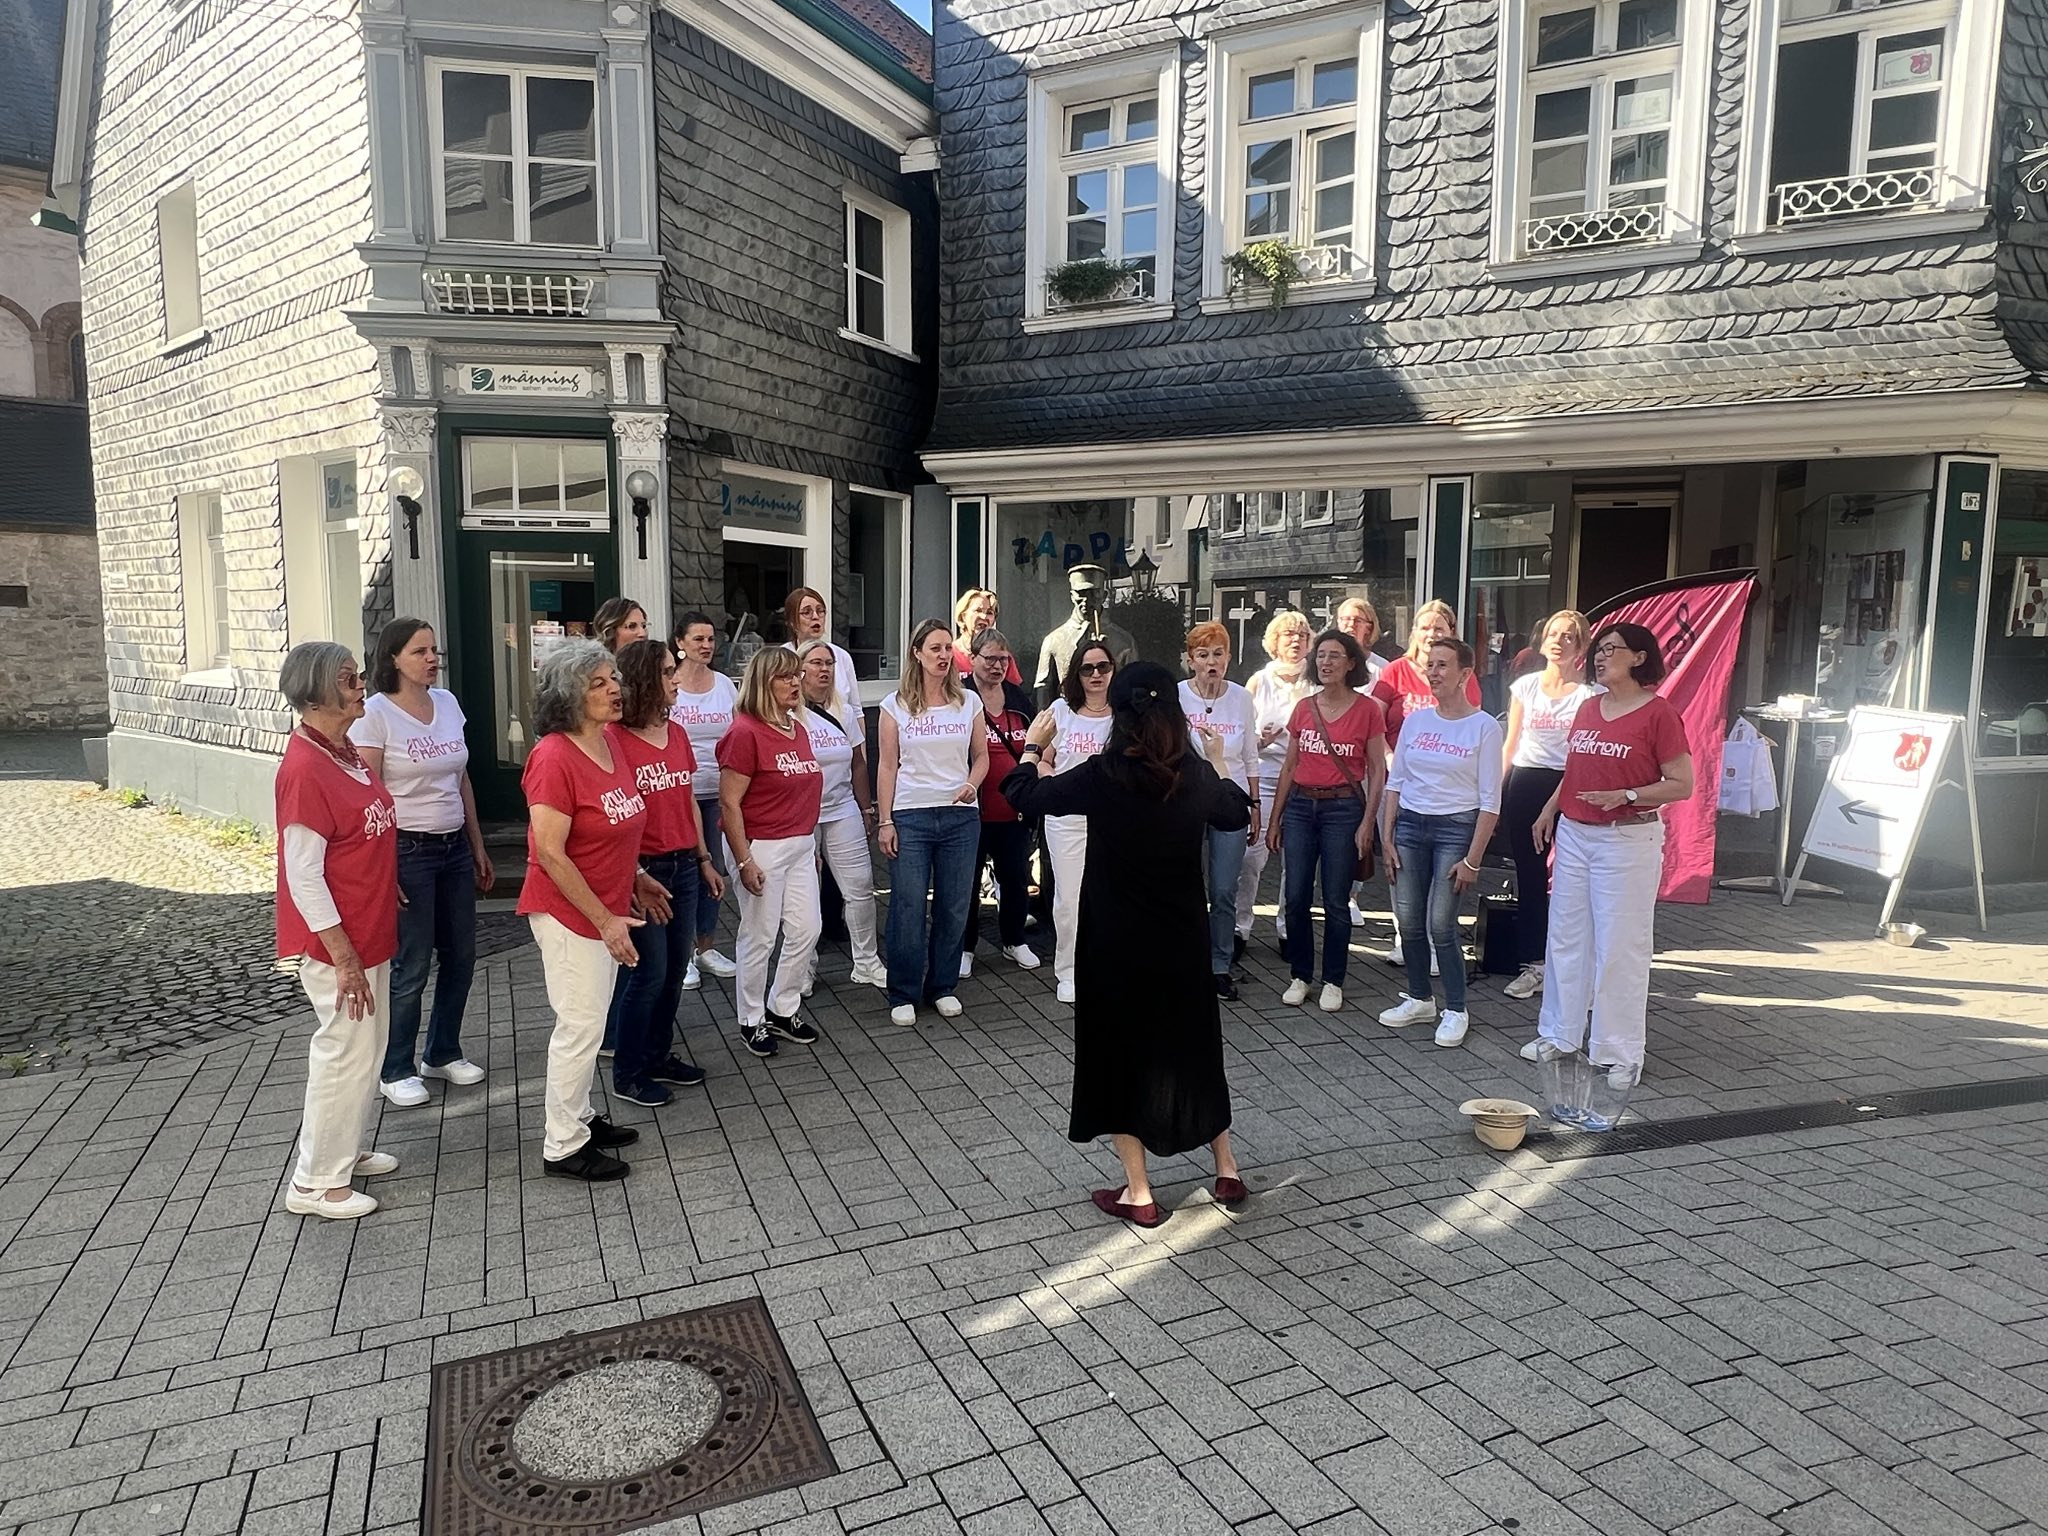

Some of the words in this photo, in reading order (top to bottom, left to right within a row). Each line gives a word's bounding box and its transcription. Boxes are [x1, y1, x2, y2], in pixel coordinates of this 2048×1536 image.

[499, 370, 581, 392] männing
[736, 490, 804, 523] männing
[681, 705, 699, 715] MISS
[682, 712, 729, 724] HARMONY
[913, 716, 935, 726] MISS
[915, 723, 967, 736] HARMONY
[411, 735, 435, 749] MISS
[1073, 732, 1095, 742] MISS
[1417, 740, 1471, 758] HARMONY
[1570, 739, 1633, 759] HARMONY
[641, 761, 668, 779] MISS
